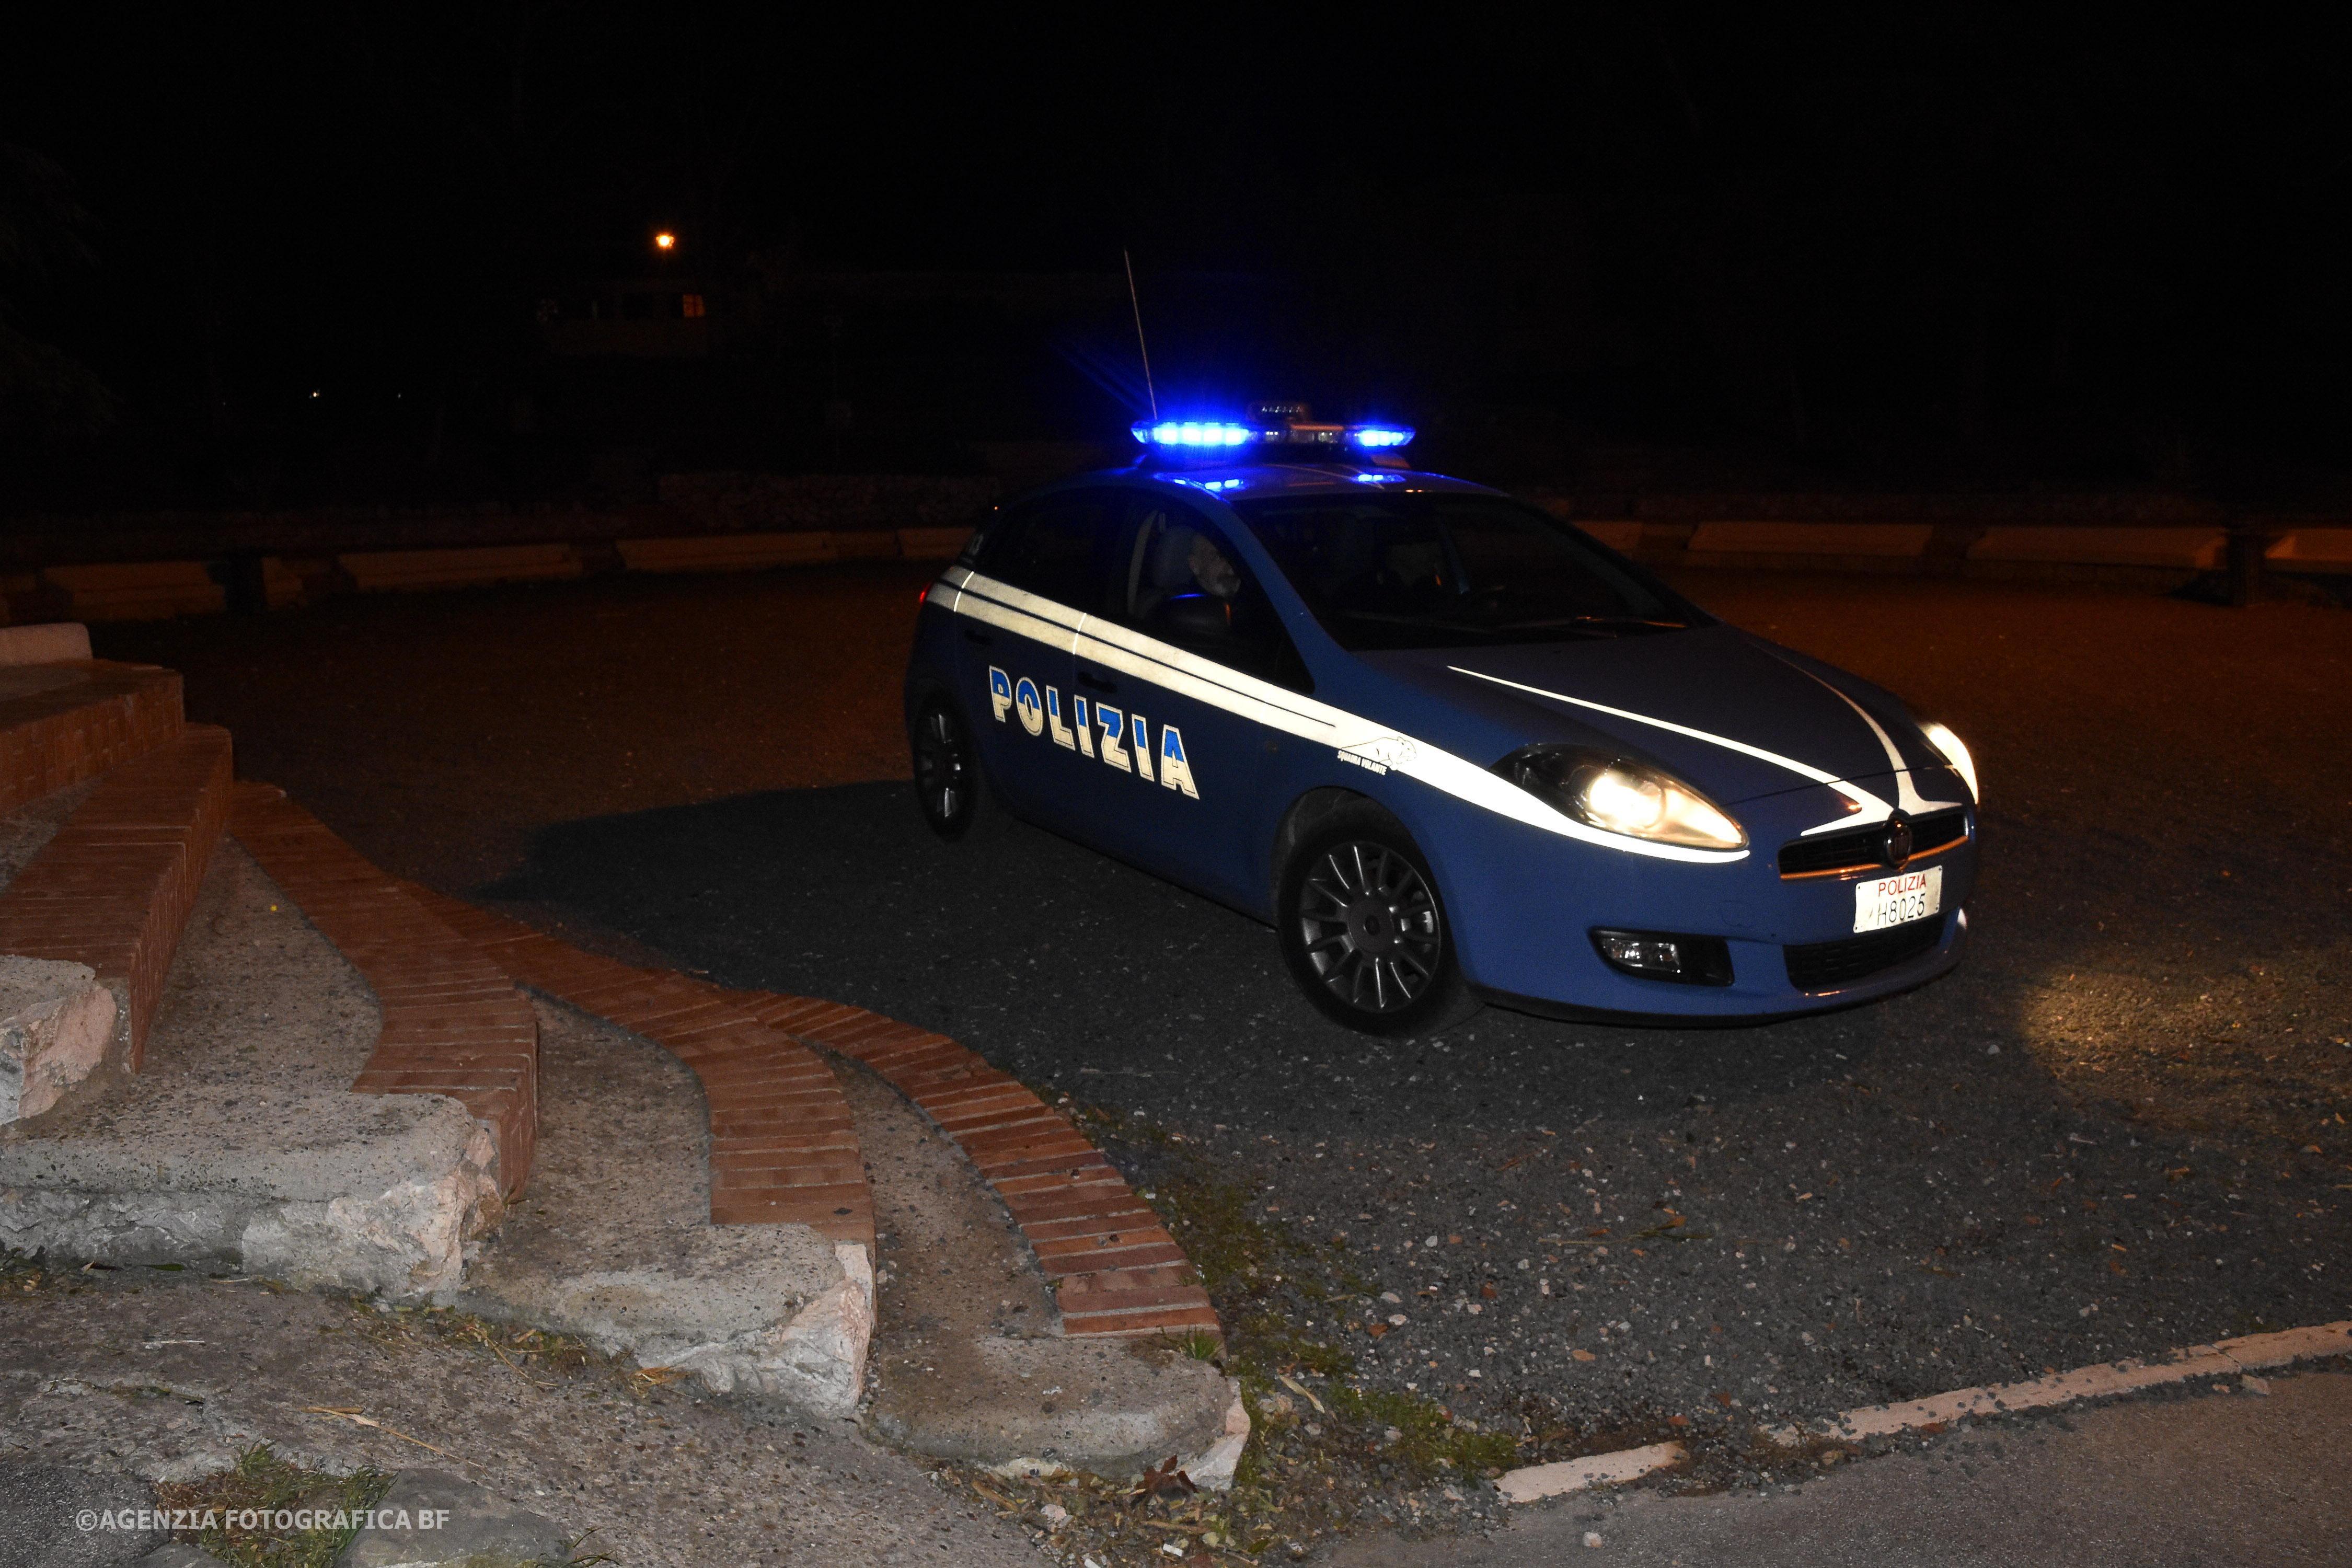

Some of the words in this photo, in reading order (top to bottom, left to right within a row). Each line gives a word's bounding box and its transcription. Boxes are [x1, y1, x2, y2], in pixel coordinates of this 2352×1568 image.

[989, 665, 1200, 800] POLIZIA
[1361, 757, 1387, 776] VOLANTE
[1878, 873, 1927, 897] POLIZIA
[1877, 893, 1926, 926] H8025
